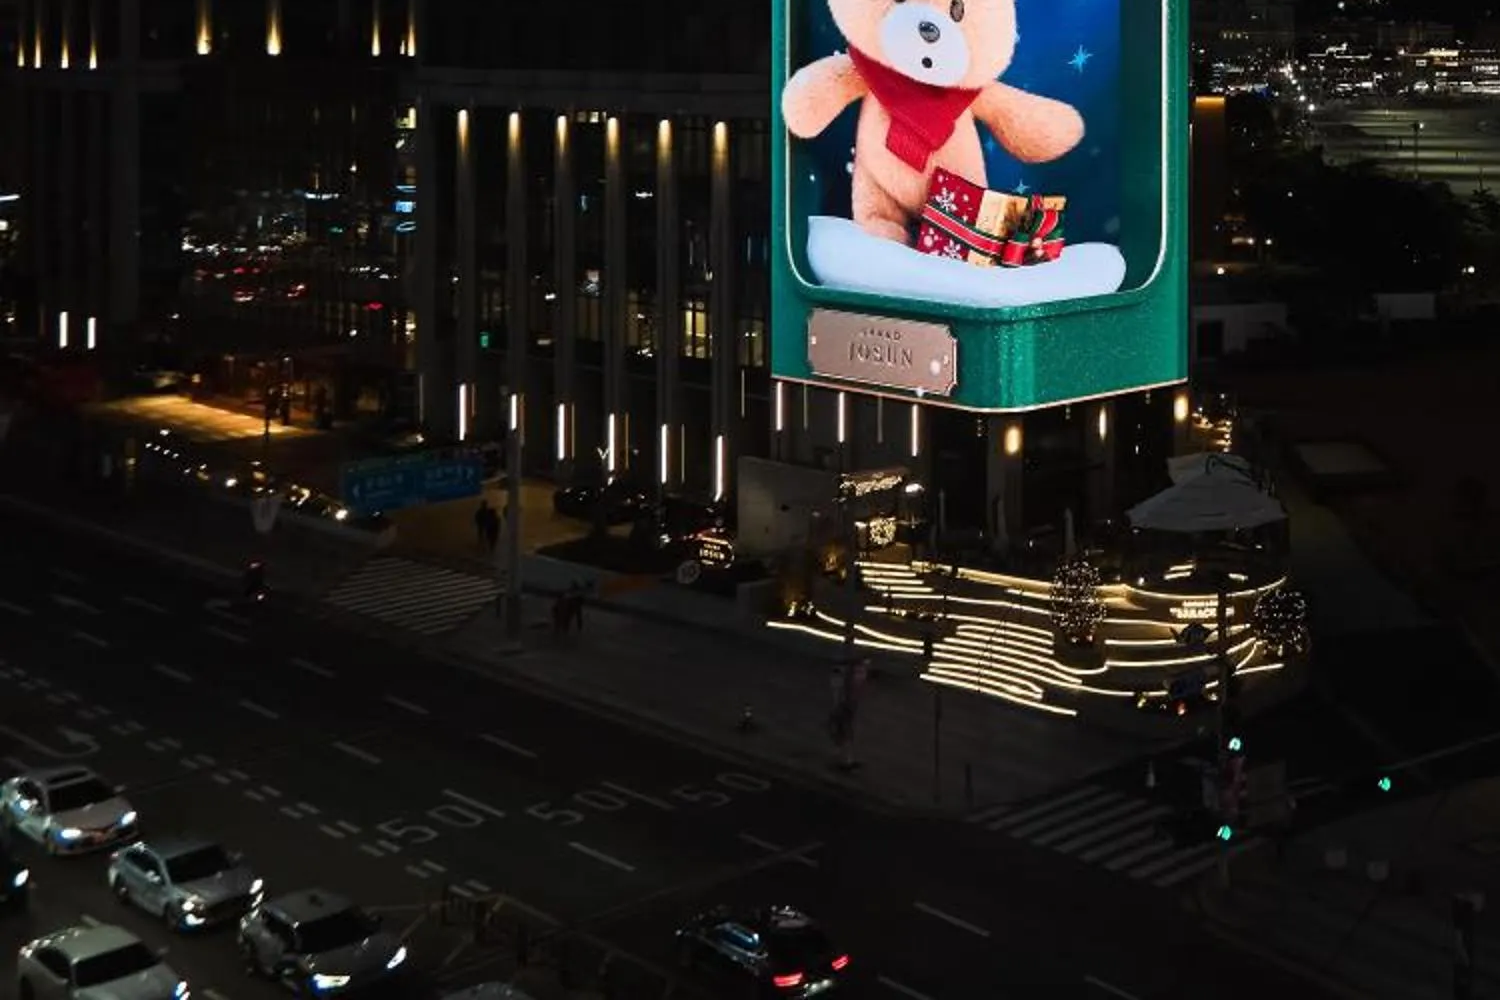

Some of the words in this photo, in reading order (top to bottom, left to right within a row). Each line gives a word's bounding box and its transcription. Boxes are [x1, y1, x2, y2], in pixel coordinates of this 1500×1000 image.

[848, 342, 913, 366] JOSUN
[376, 803, 486, 844] 50
[524, 790, 629, 826] 50
